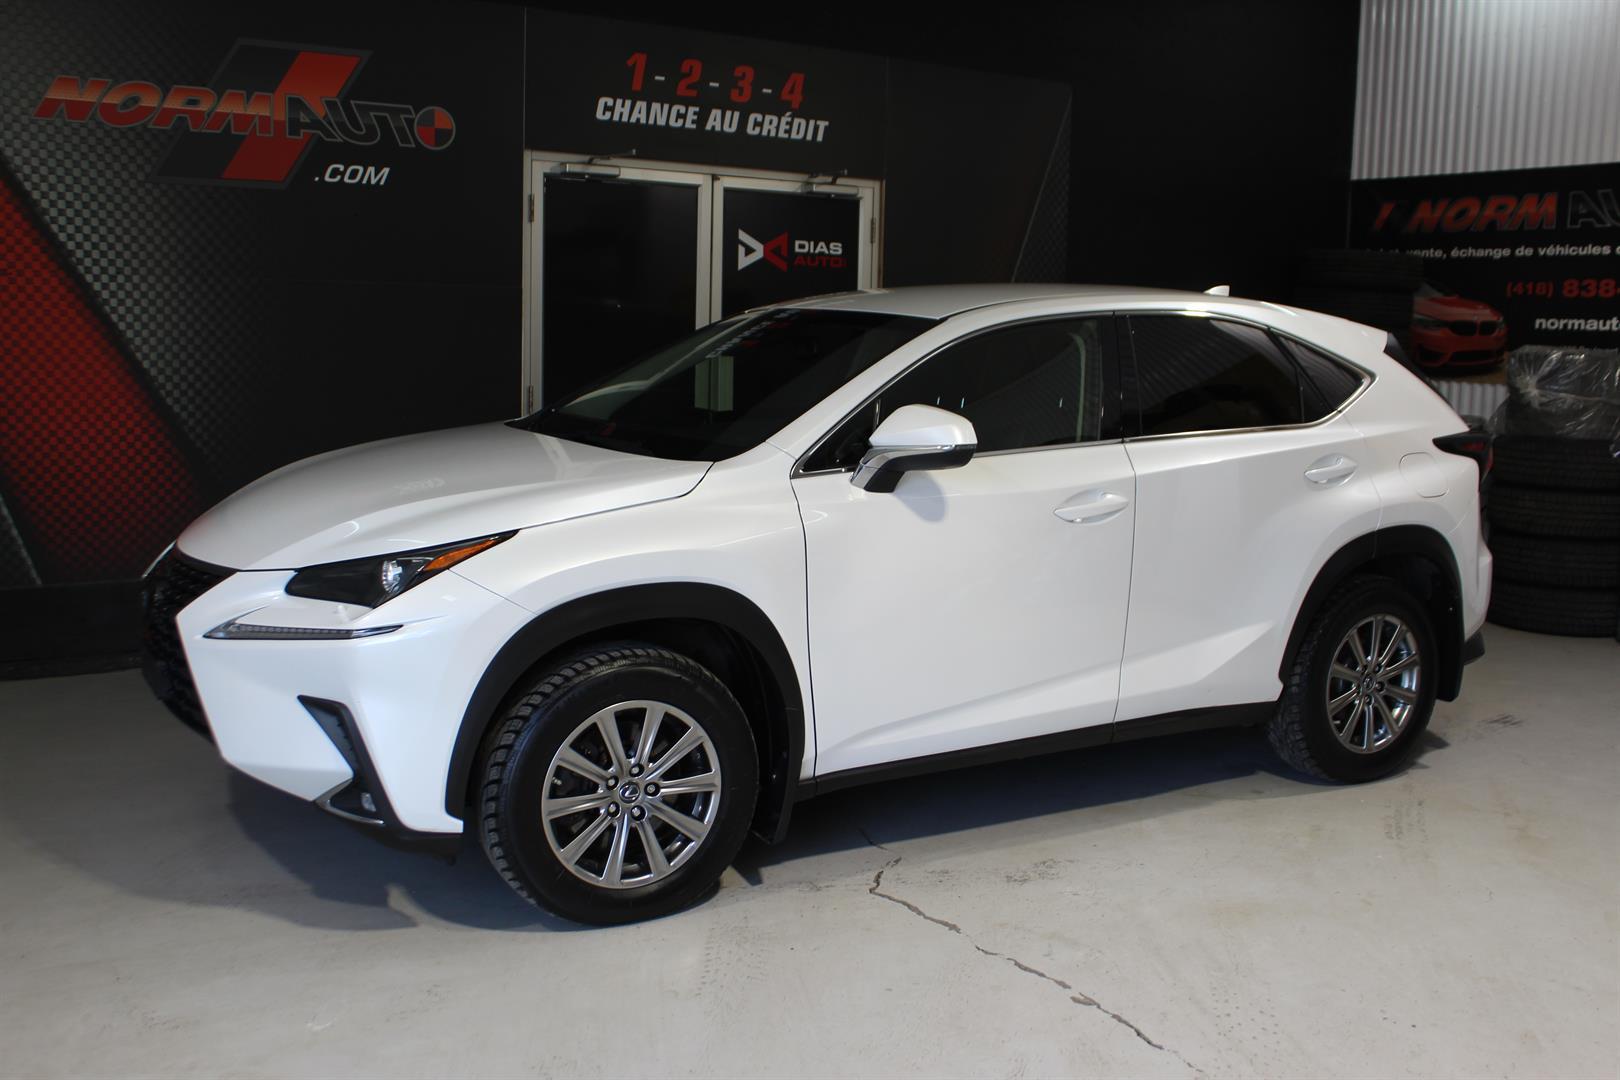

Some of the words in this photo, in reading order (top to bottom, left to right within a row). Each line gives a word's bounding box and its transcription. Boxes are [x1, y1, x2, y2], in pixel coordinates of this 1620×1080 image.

[595, 96, 700, 130] CHANCE
[704, 107, 741, 134] AU
[745, 111, 830, 142] CRÉDIT
[313, 162, 391, 186] .COM
[1405, 192, 1559, 233] NORM
[794, 239, 843, 255] DIAS
[1450, 244, 1512, 260] échange
[1514, 244, 1534, 257] de
[1537, 243, 1612, 257] véhicules
[1505, 279, 1556, 300] (418)
[1534, 315, 1620, 332] normaut
